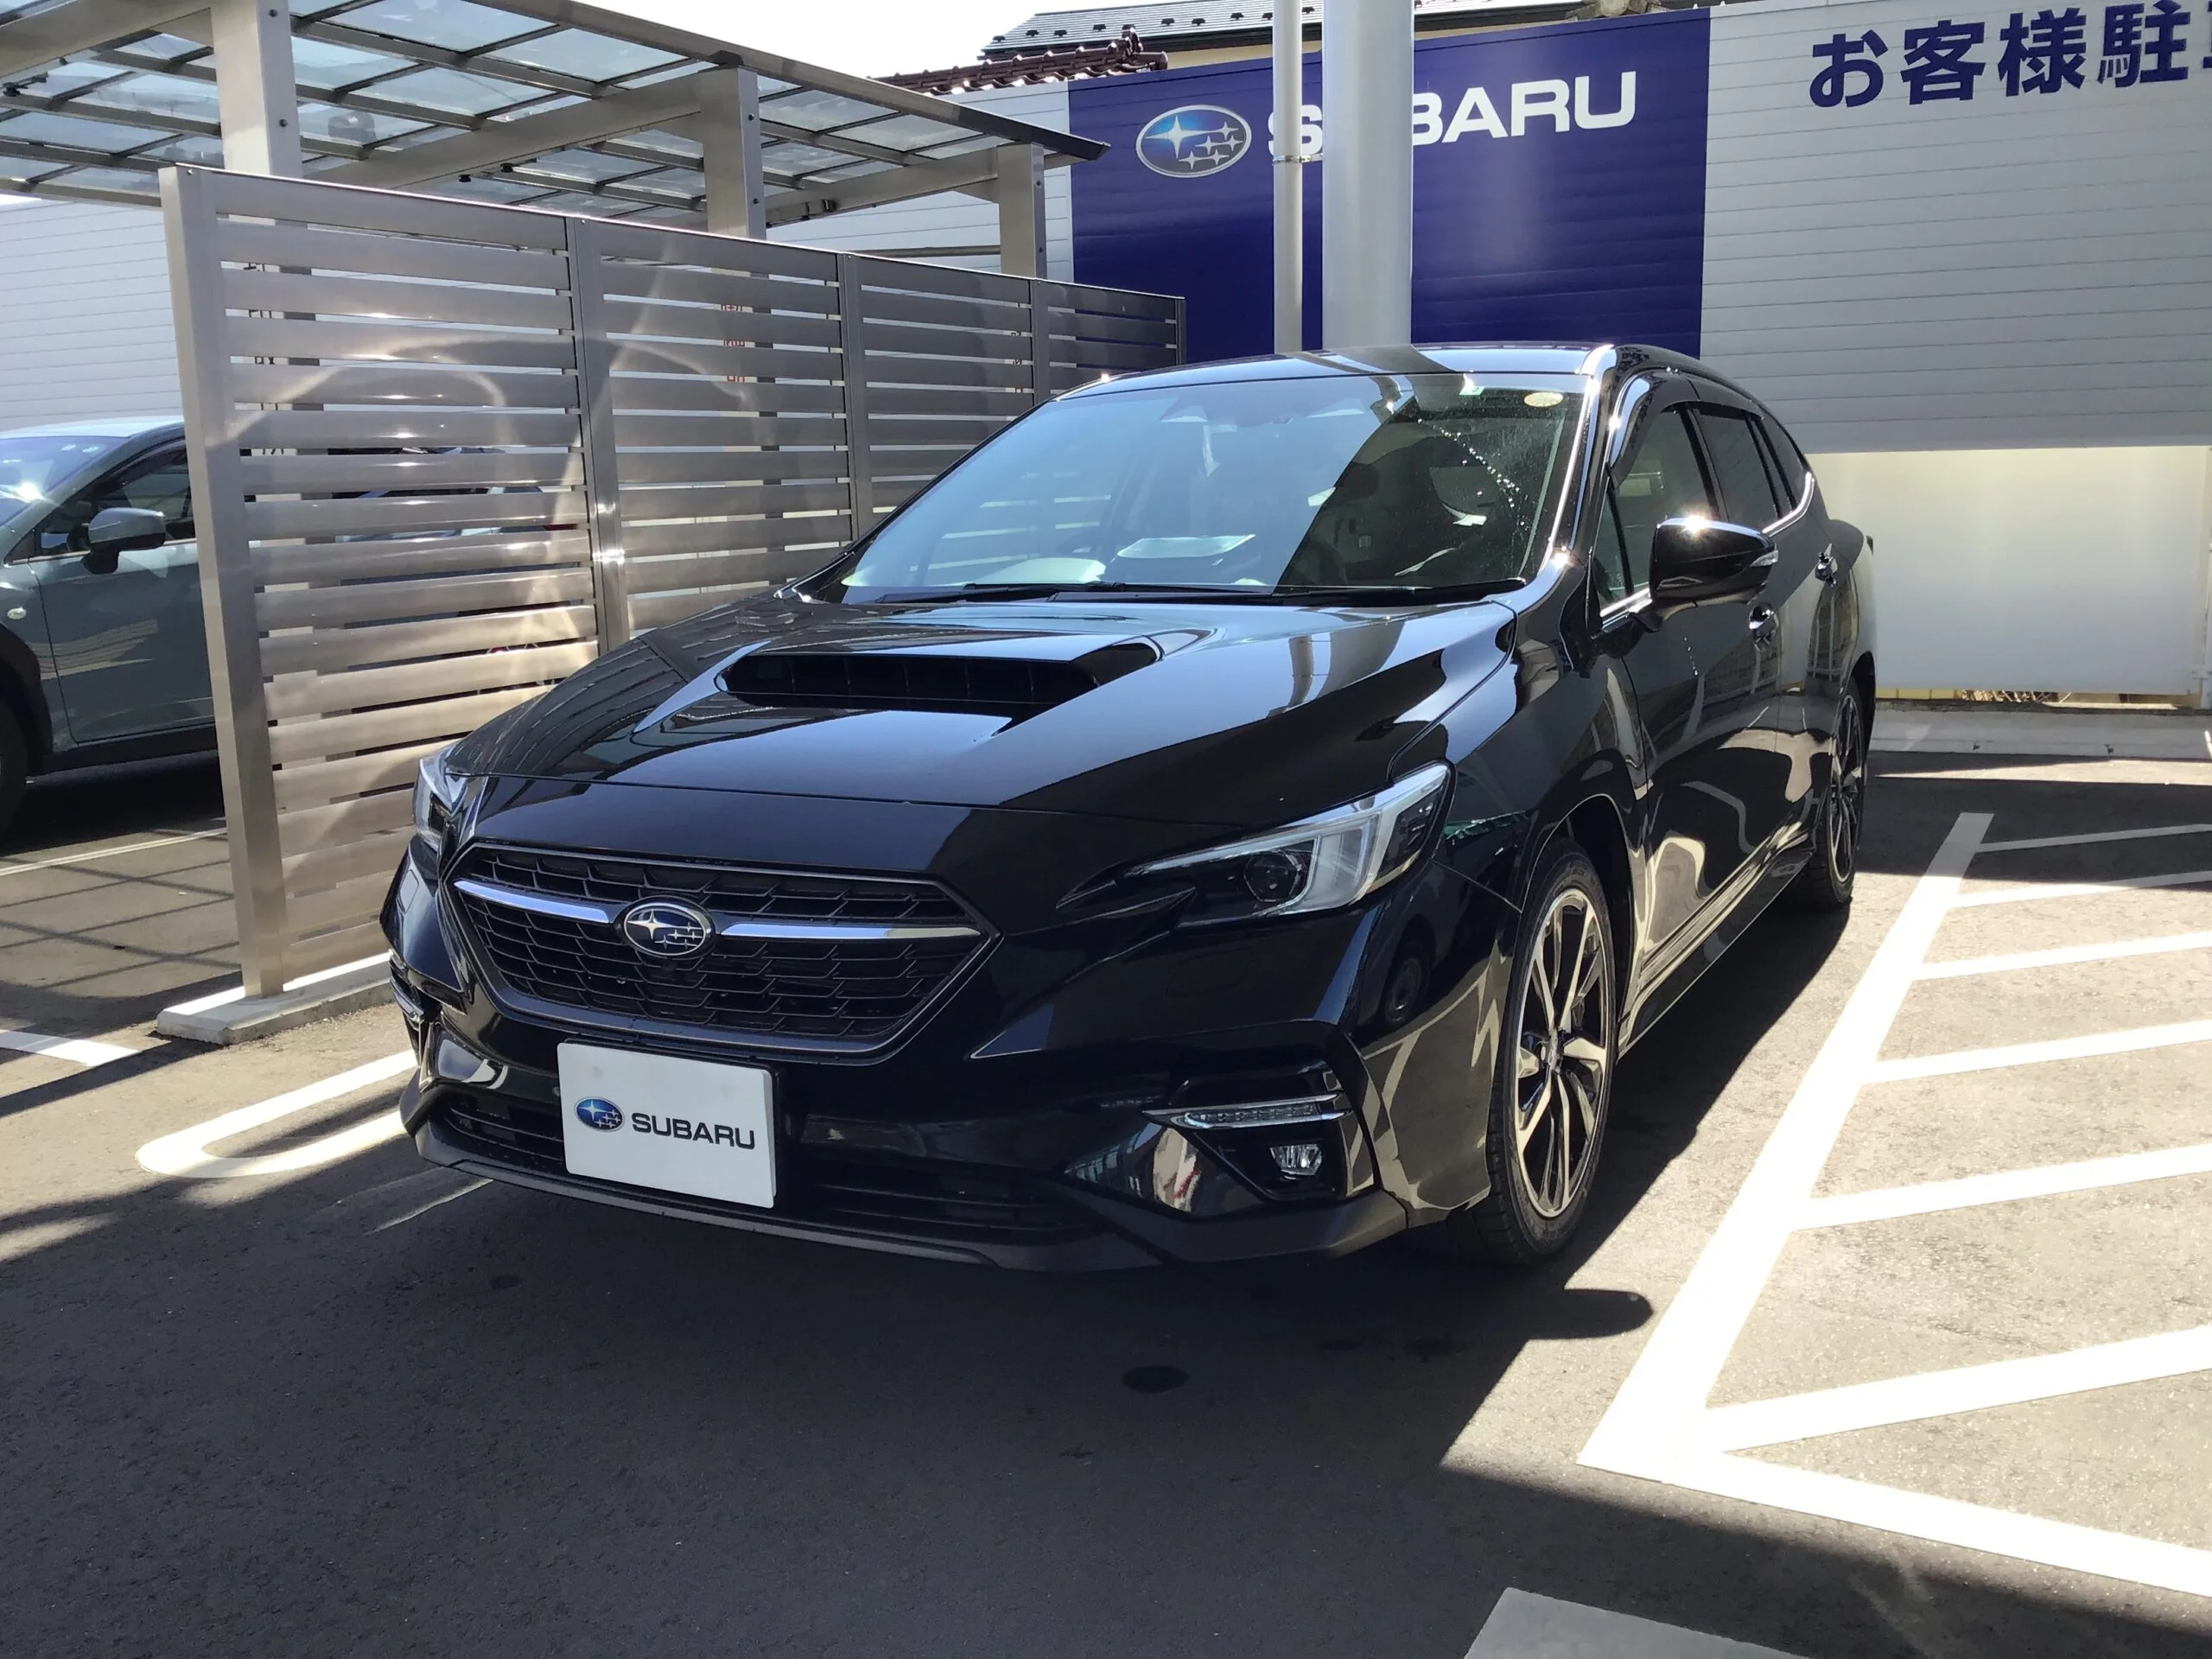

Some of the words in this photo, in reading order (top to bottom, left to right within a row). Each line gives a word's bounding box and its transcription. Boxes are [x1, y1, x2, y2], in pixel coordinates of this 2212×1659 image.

[1809, 0, 2212, 108] お客様駐
[1268, 71, 1636, 156] SBARU
[632, 1112, 755, 1150] SUBARU
